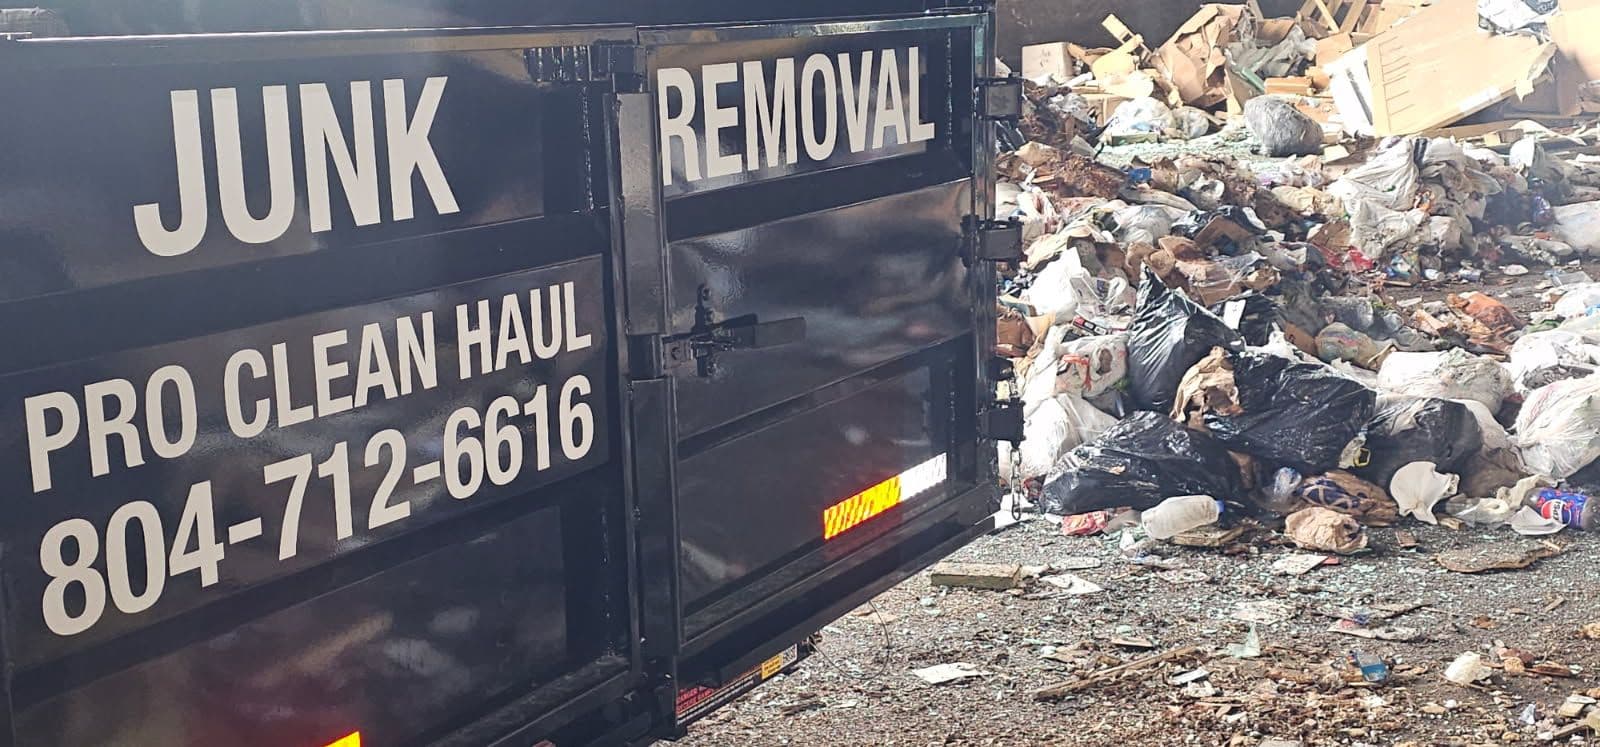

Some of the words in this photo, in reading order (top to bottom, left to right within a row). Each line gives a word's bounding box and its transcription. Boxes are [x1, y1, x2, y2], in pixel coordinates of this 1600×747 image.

[134, 77, 460, 256] JUNK
[657, 47, 935, 186] REMOVAL
[25, 365, 197, 492] PRO
[224, 311, 437, 438] CLEAN
[456, 282, 591, 379] HAUL
[41, 375, 593, 635] 804-712-6616
